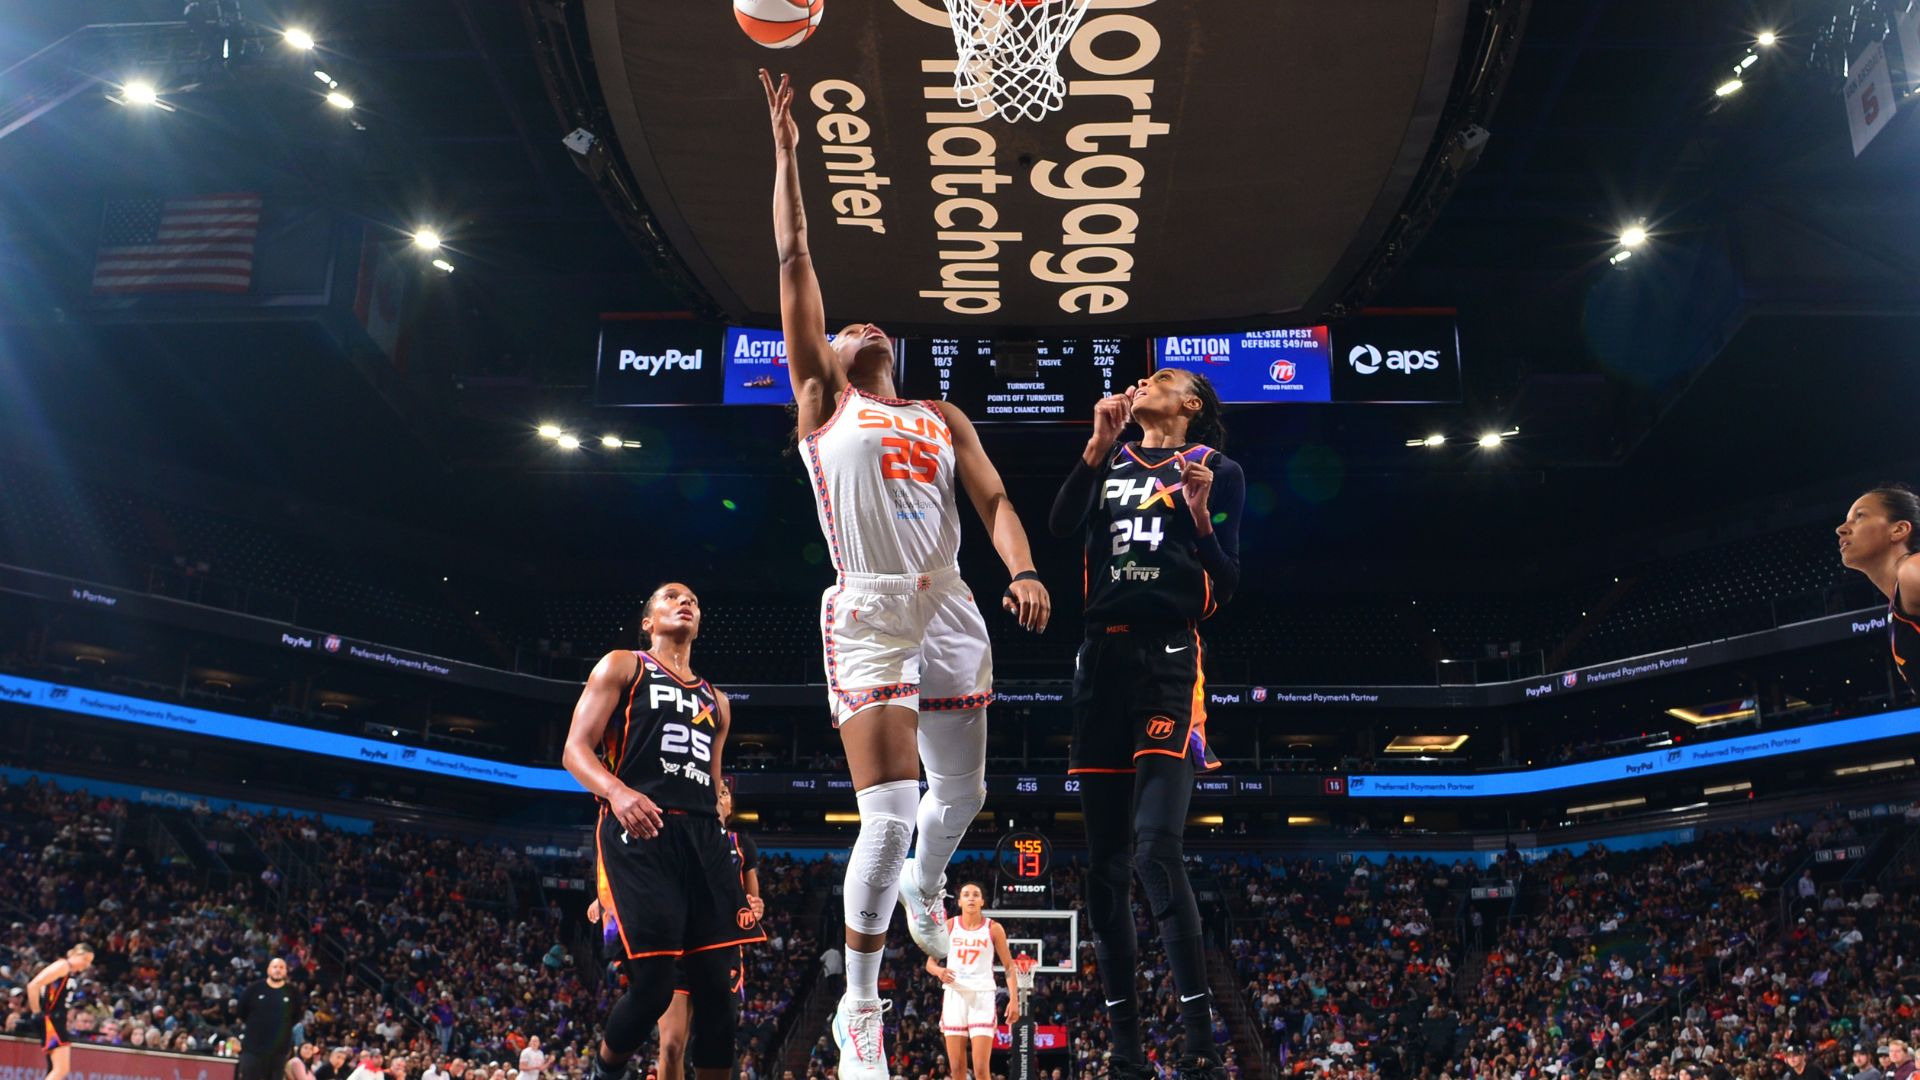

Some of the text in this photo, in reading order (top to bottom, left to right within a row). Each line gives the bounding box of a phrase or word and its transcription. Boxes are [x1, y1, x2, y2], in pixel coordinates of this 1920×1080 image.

[1861, 83, 1879, 125] 5
[810, 79, 891, 234] center
[1029, 0, 1170, 314] ortgage
[919, 59, 1023, 314] matchup
[1246, 329, 1312, 338] ALL-STAR PEST
[734, 335, 788, 358] ACTIO
[931, 345, 959, 355] 81.8%
[1092, 345, 1121, 355] 71.4%
[1165, 336, 1230, 355] ACTION
[1241, 339, 1318, 349] DEFENSE $49/mo
[619, 349, 703, 376] PayPal
[934, 357, 952, 366] 18/3
[1093, 356, 1115, 366] 22/5
[1385, 350, 1439, 374] aps
[940, 368, 950, 378] 10
[1102, 368, 1112, 378] 15
[939, 380, 950, 390] 10
[1007, 382, 1045, 390] TURNOVERS
[1104, 380, 1111, 389] 8
[987, 394, 1064, 402] POINTS OFF TURNOVERS
[987, 406, 1064, 414] SECOND CHANCE POINTS
[857, 408, 952, 448] SUN
[881, 437, 939, 484] 25
[1100, 476, 1186, 510] PHX
[1109, 516, 1164, 556] 24
[1852, 617, 1885, 633] PayPal
[282, 633, 311, 648] PayPal
[350, 646, 449, 674] Preferred Payments Partner
[1587, 656, 1688, 683] Preferred Payments Partner
[726, 691, 750, 701] artner
[1525, 684, 1551, 697] PayPal
[998, 692, 1034, 703] Payments
[1035, 692, 1063, 701] Partner
[1211, 694, 1239, 704] PayPal
[1277, 692, 1379, 703] Preferred Payments Partner
[649, 684, 716, 728] PHX
[660, 722, 711, 762] 25
[360, 748, 388, 759] PayPal
[1692, 737, 1801, 760] Preferred Payments Partner
[1626, 762, 1653, 774] PayPal
[809, 780, 815, 789] 2
[1064, 780, 1080, 792] 62
[1196, 782, 1202, 790] 4
[1375, 782, 1475, 792] Preferred Payments Partner
[1014, 840, 1042, 853] 4:55
[1018, 854, 1040, 876] 13
[952, 938, 988, 948] SUN
[957, 949, 980, 965] 47
[1019, 1025, 1028, 1052] Health
